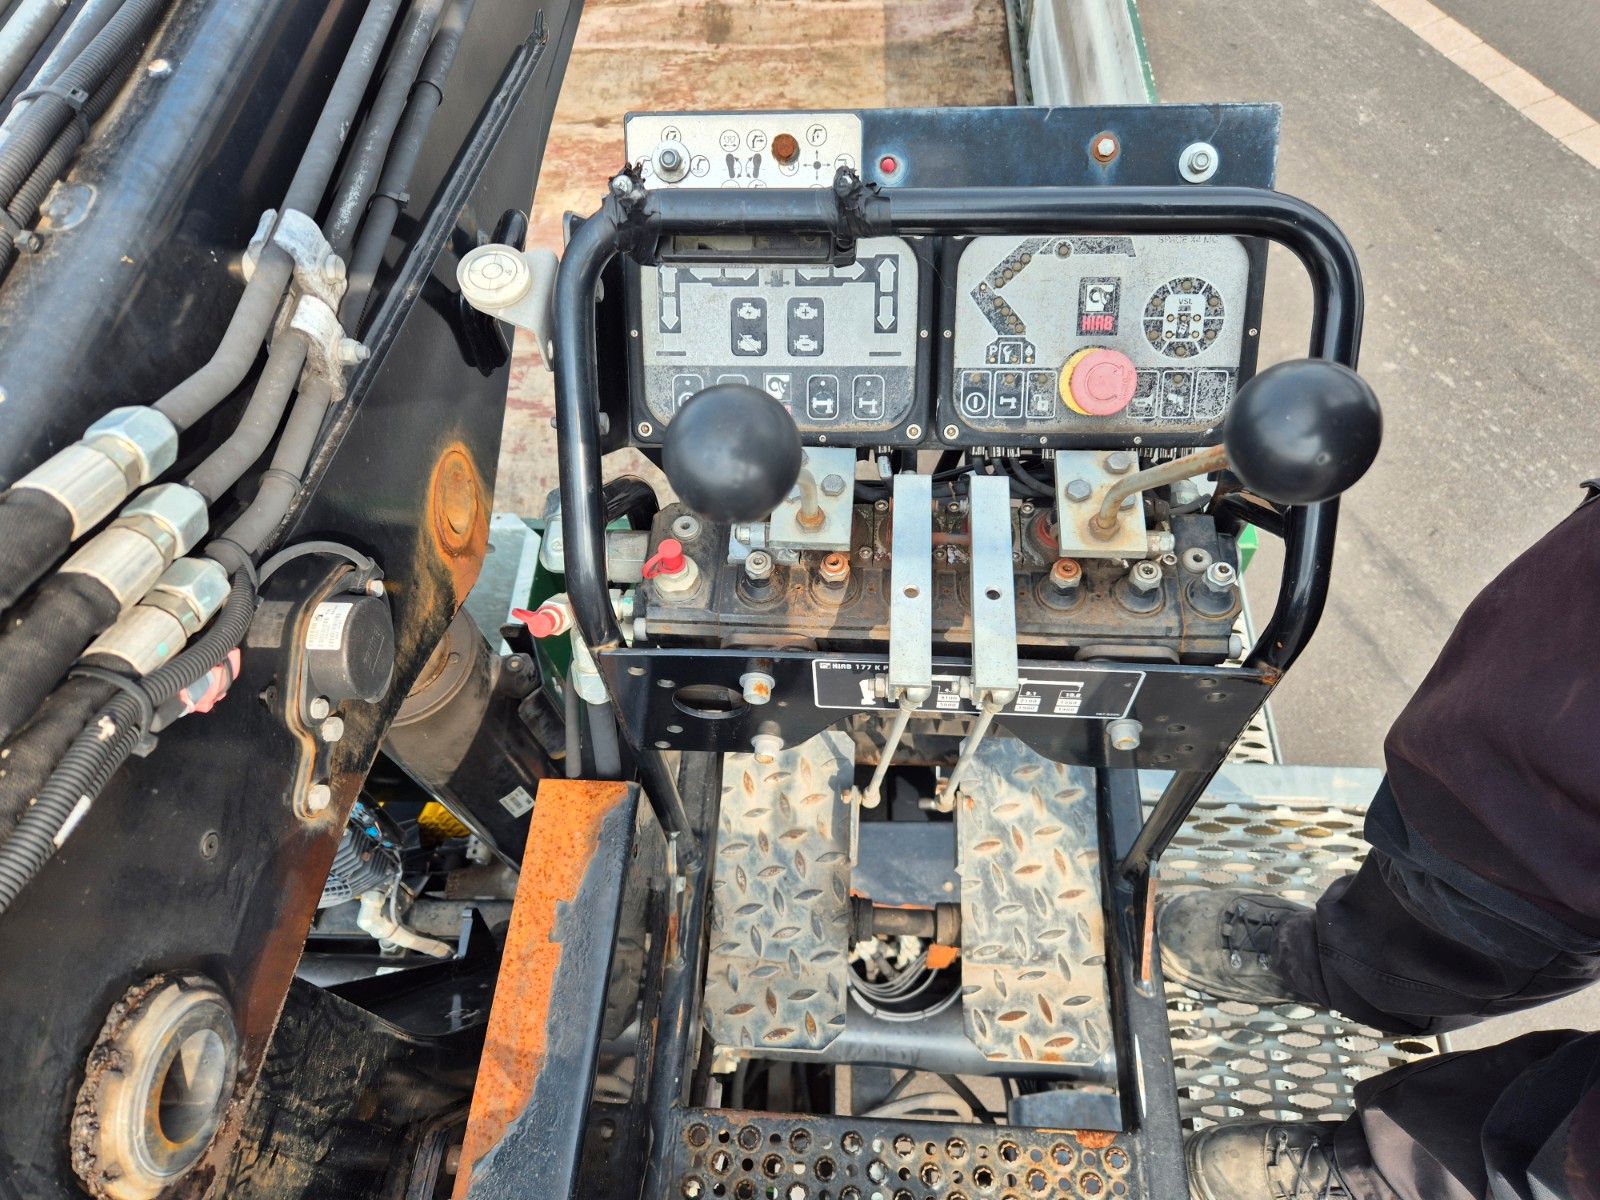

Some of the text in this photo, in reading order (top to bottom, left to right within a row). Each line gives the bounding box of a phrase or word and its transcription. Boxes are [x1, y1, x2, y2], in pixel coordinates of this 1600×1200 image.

[1081, 315, 1114, 331] HIAB
[832, 662, 852, 670] HIAB
[855, 663, 872, 671] 177
